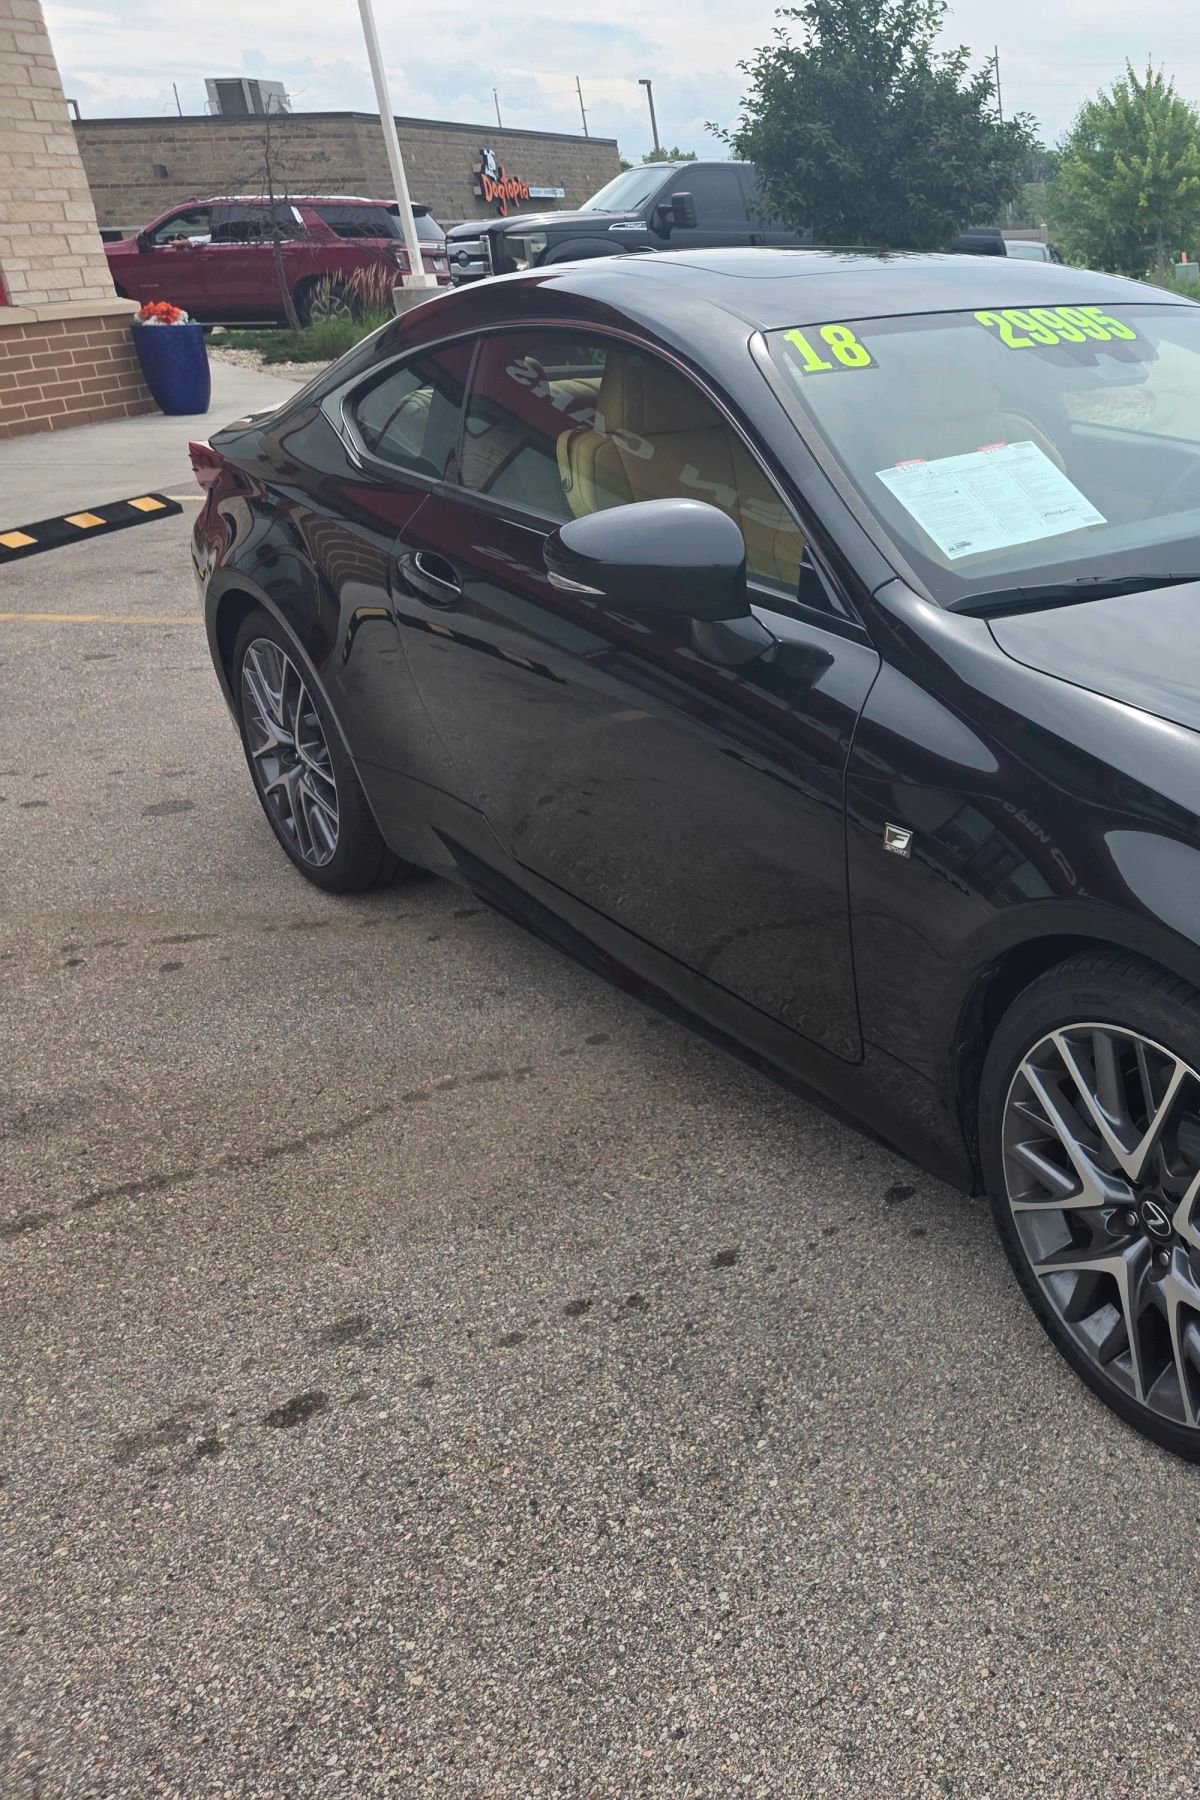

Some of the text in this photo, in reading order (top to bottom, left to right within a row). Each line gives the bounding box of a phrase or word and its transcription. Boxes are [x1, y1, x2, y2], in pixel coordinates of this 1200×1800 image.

[481, 164, 529, 217] Dogtopia
[785, 325, 871, 372] 18
[974, 307, 1137, 348] 29995
[885, 843, 908, 857] SPORT
